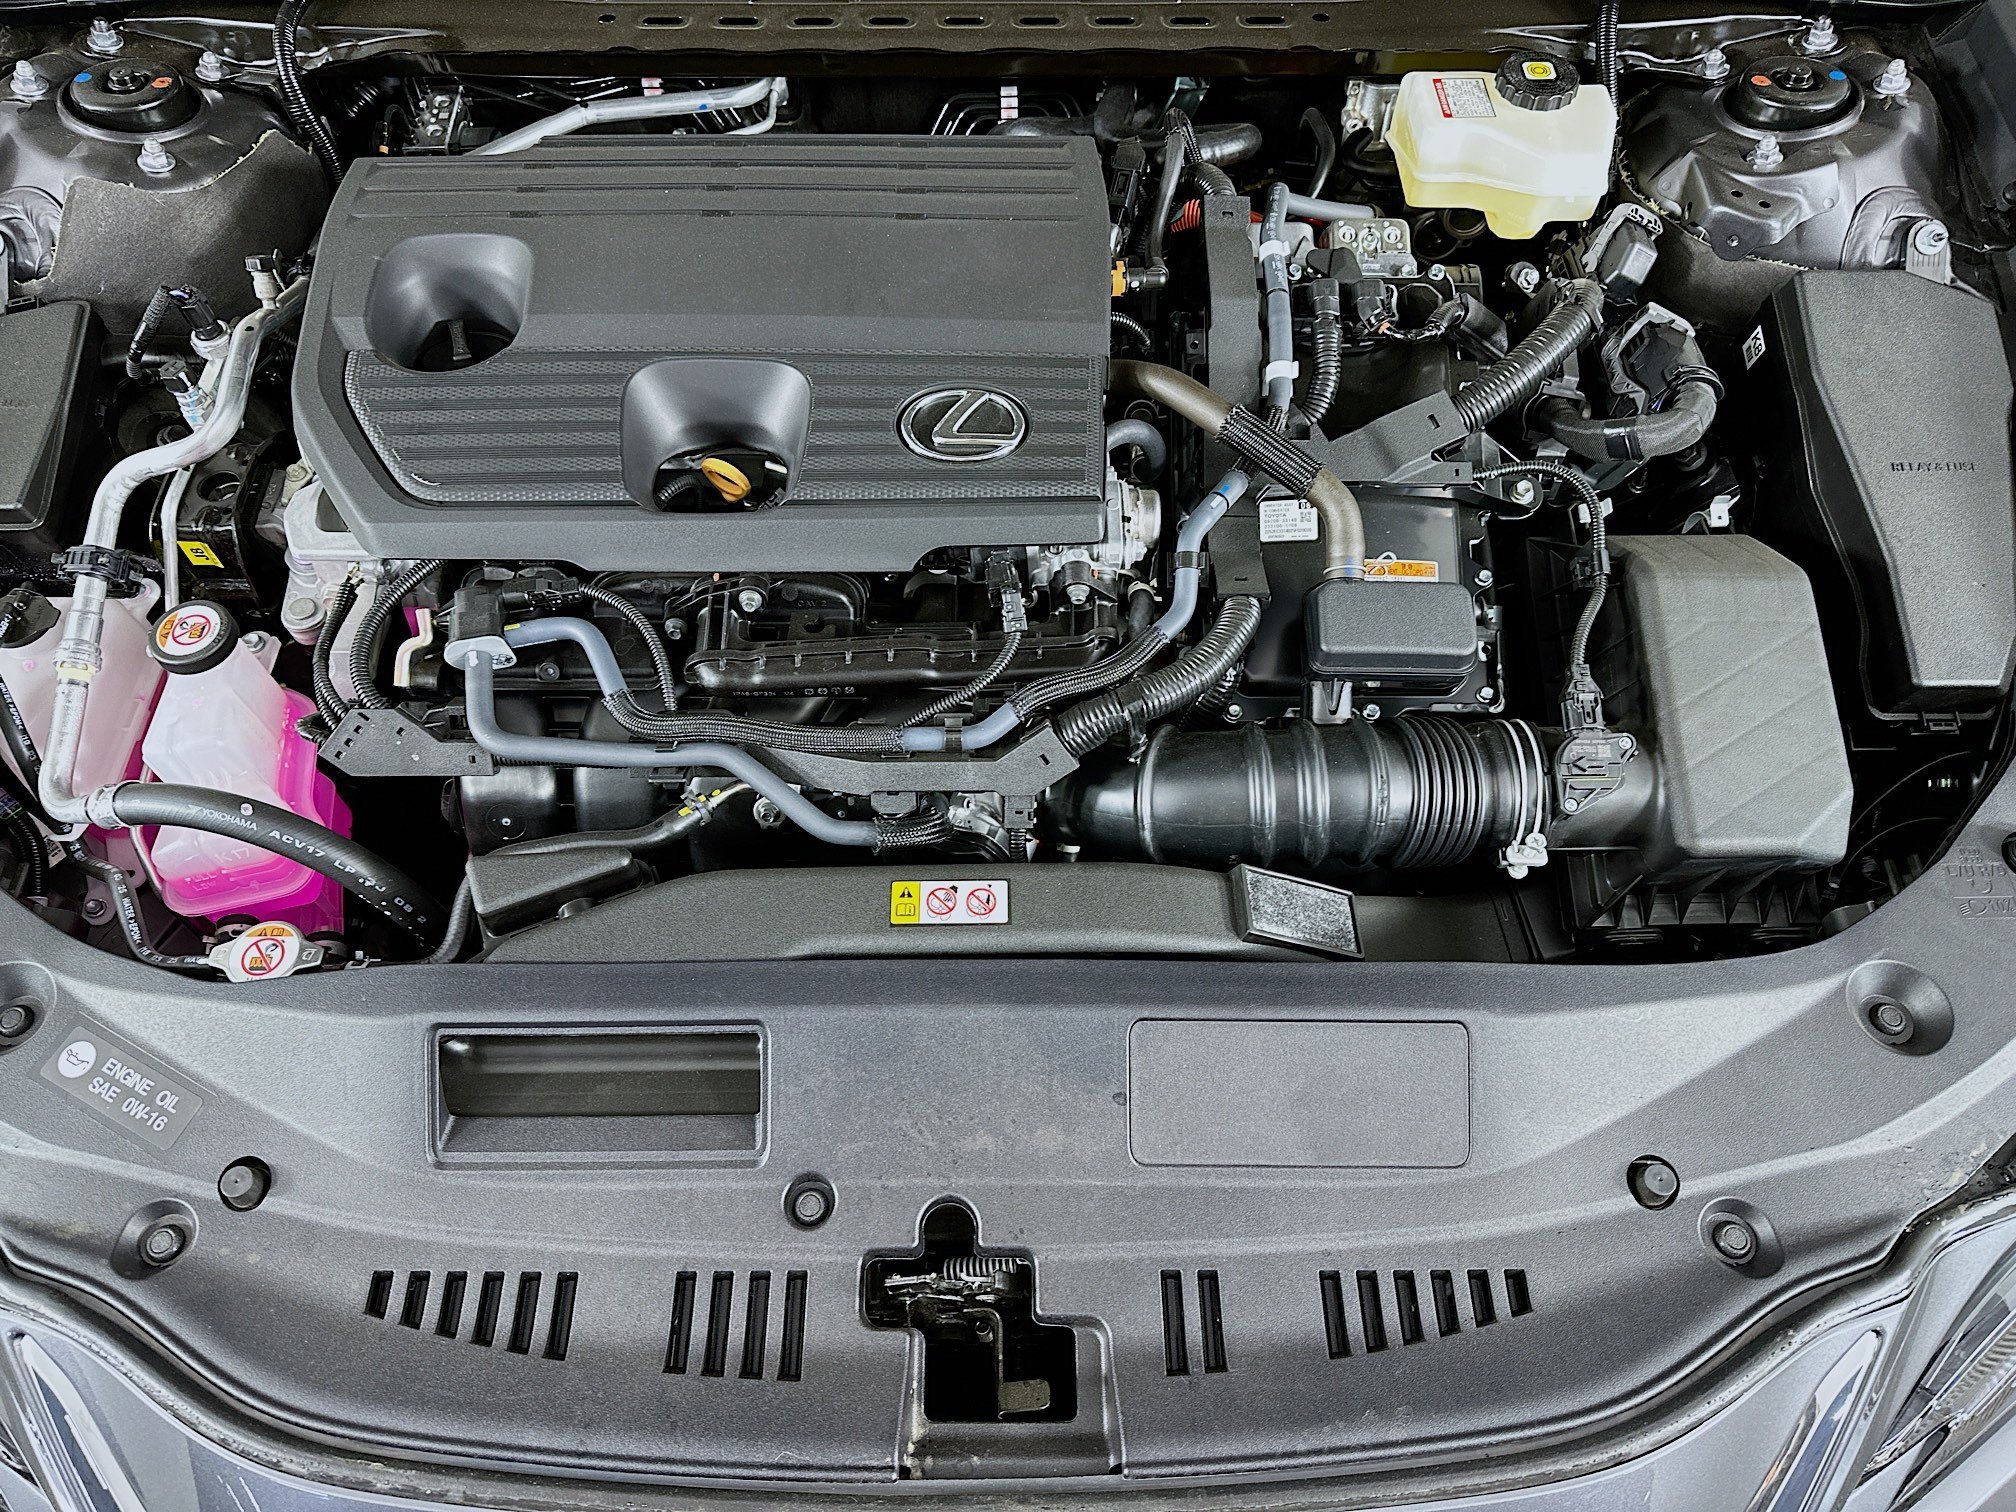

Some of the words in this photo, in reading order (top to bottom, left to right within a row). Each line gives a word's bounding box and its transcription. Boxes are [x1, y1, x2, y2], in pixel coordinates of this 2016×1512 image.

[202, 807, 257, 831] YOKOHAMA
[268, 829, 326, 858] ACV17
[333, 859, 356, 874] LP
[87, 1076, 122, 1103] SAE
[121, 1096, 169, 1132] 0W-16
[101, 1057, 156, 1097] ENGINE
[155, 1089, 180, 1114] OIL
